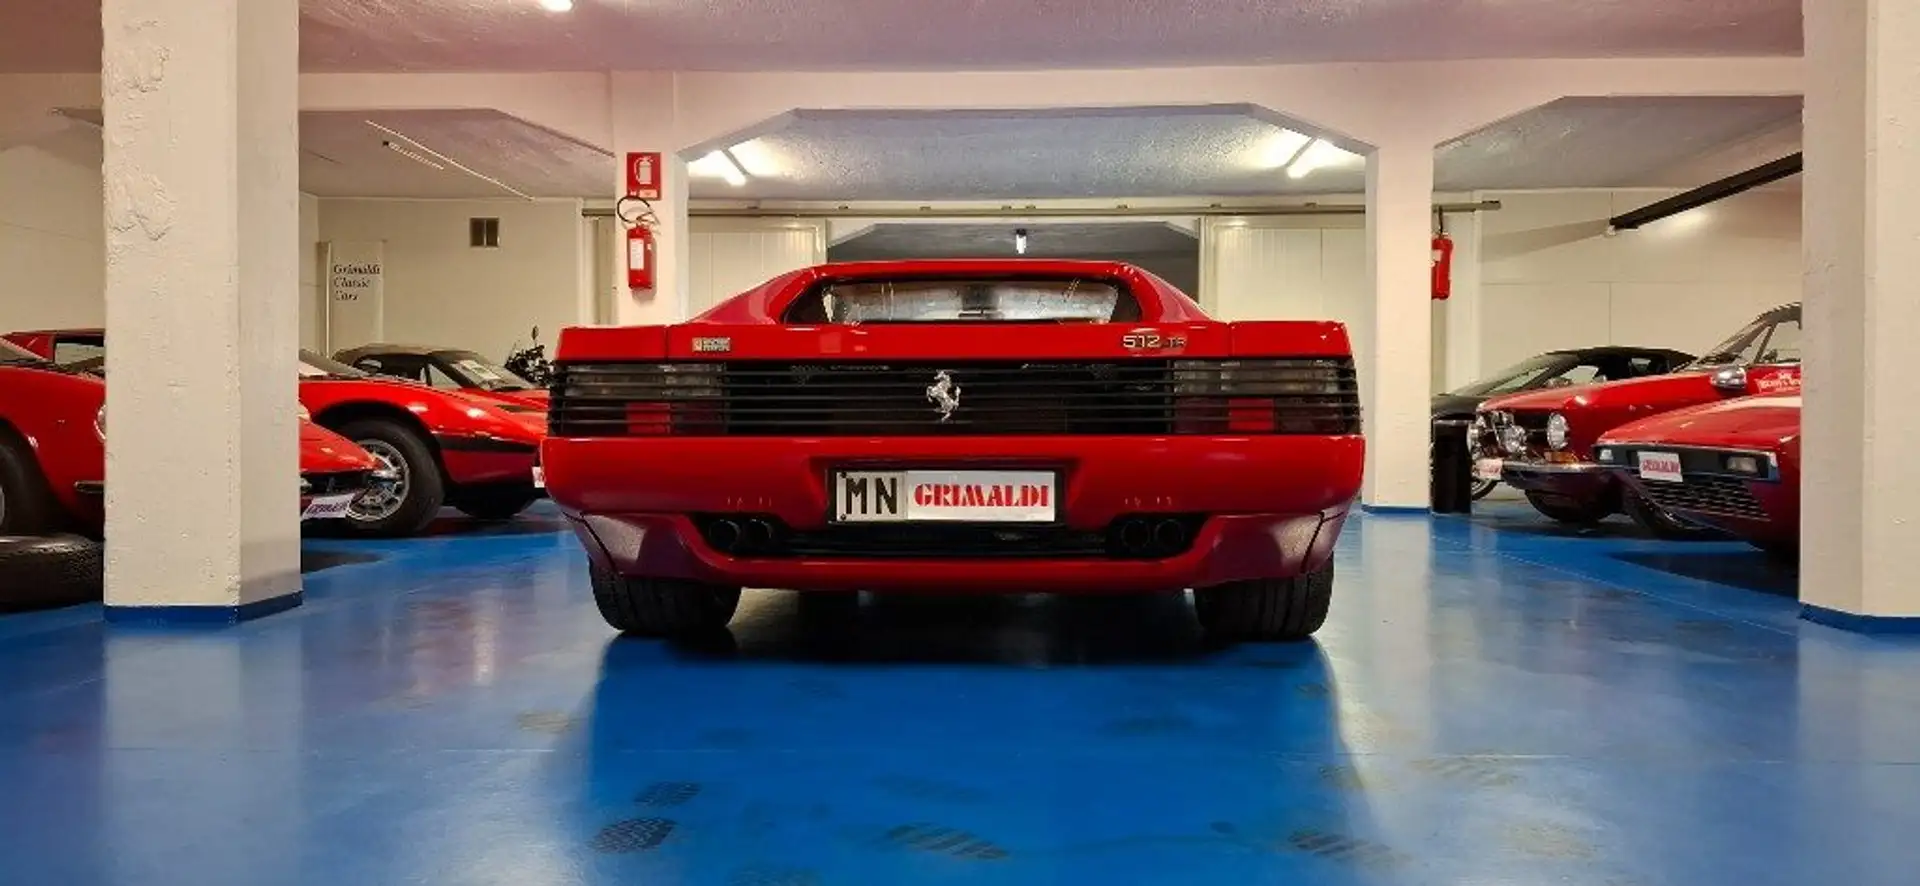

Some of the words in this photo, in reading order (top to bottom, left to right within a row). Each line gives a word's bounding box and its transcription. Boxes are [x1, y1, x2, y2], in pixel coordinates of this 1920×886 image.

[334, 264, 380, 274] Grimaldi
[334, 277, 369, 288] Classic
[335, 290, 358, 301] Cars
[1123, 335, 1160, 348] 512
[845, 477, 897, 514] MN
[914, 484, 1049, 507] GRIMALDI
